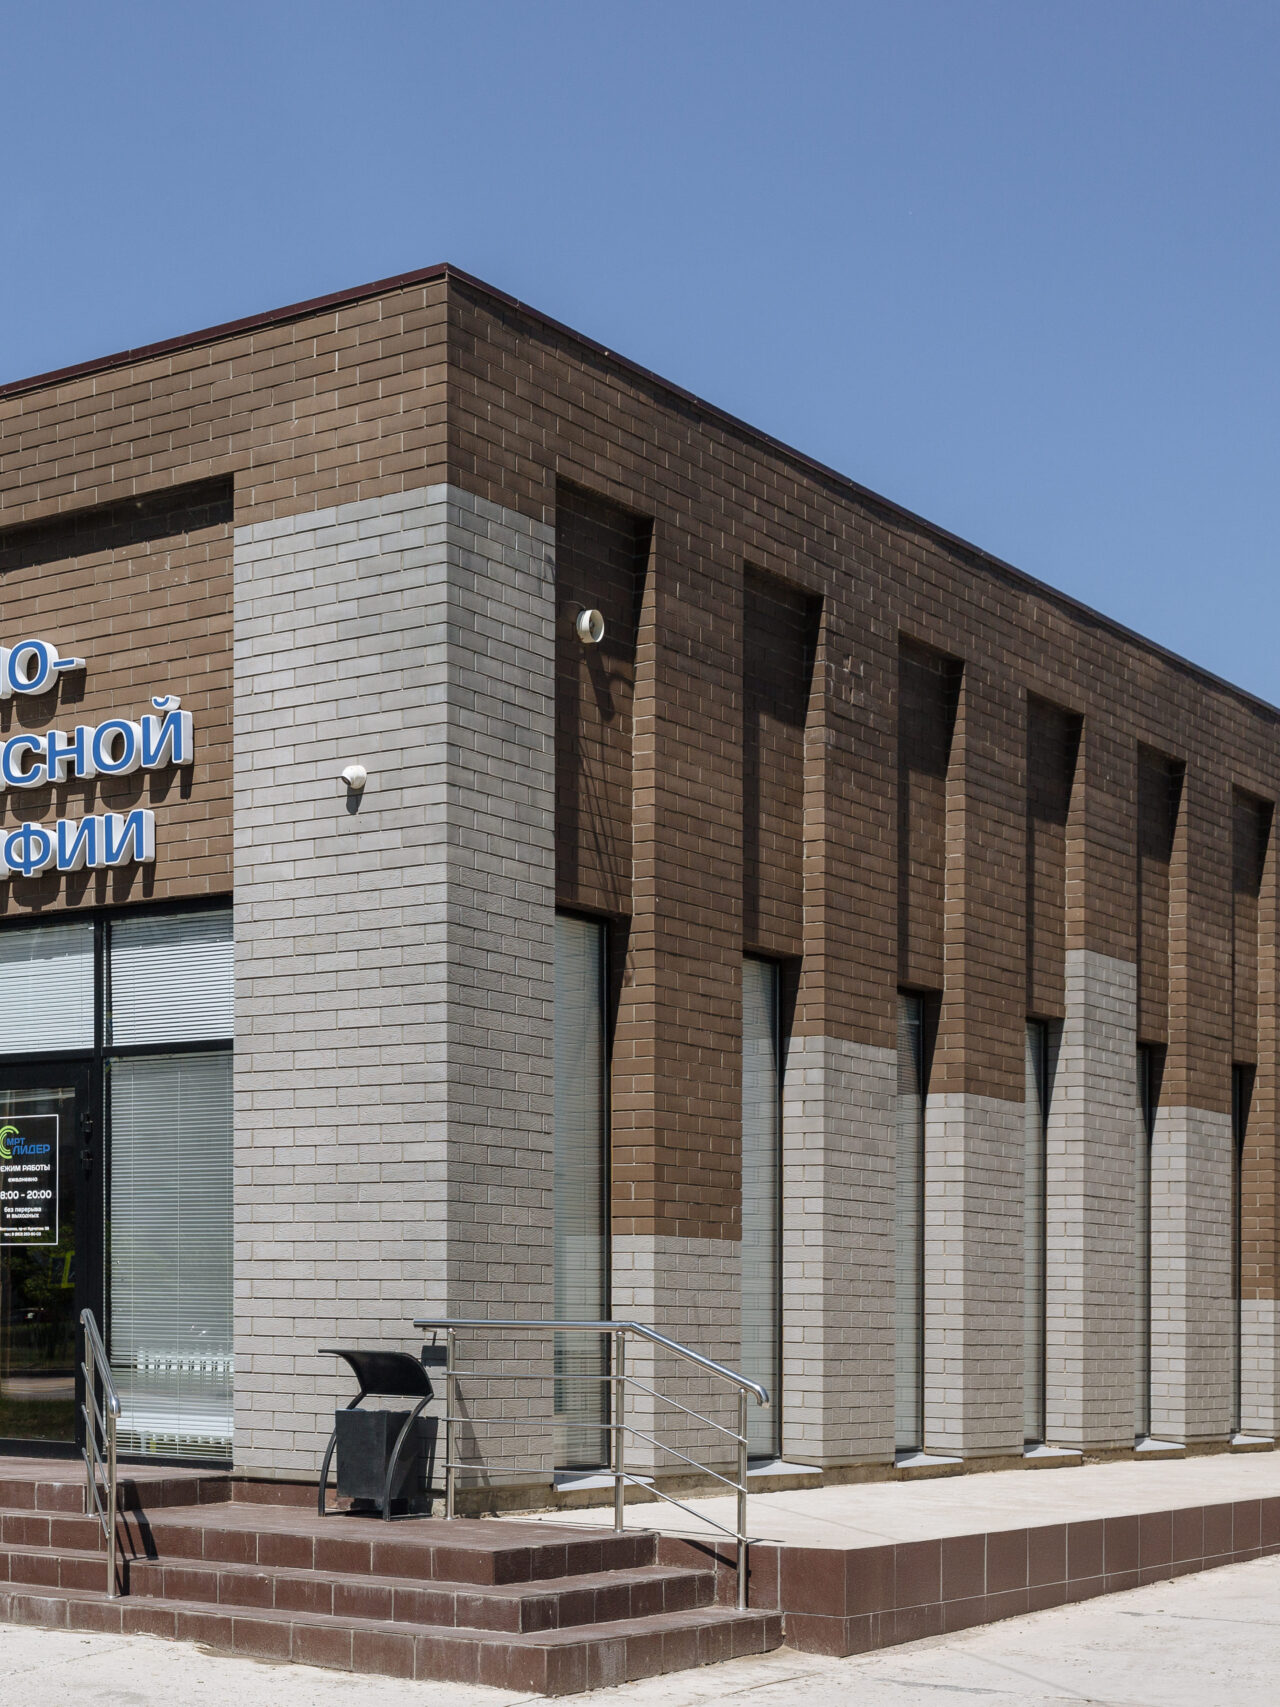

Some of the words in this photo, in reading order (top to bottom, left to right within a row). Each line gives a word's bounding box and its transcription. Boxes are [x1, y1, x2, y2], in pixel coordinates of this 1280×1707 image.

[6, 1137, 25, 1146] МРТ
[12, 1144, 51, 1155] ЛИДЕР
[22, 1164, 51, 1172] РАБОТЫ
[26, 1190, 52, 1199] 20:00
